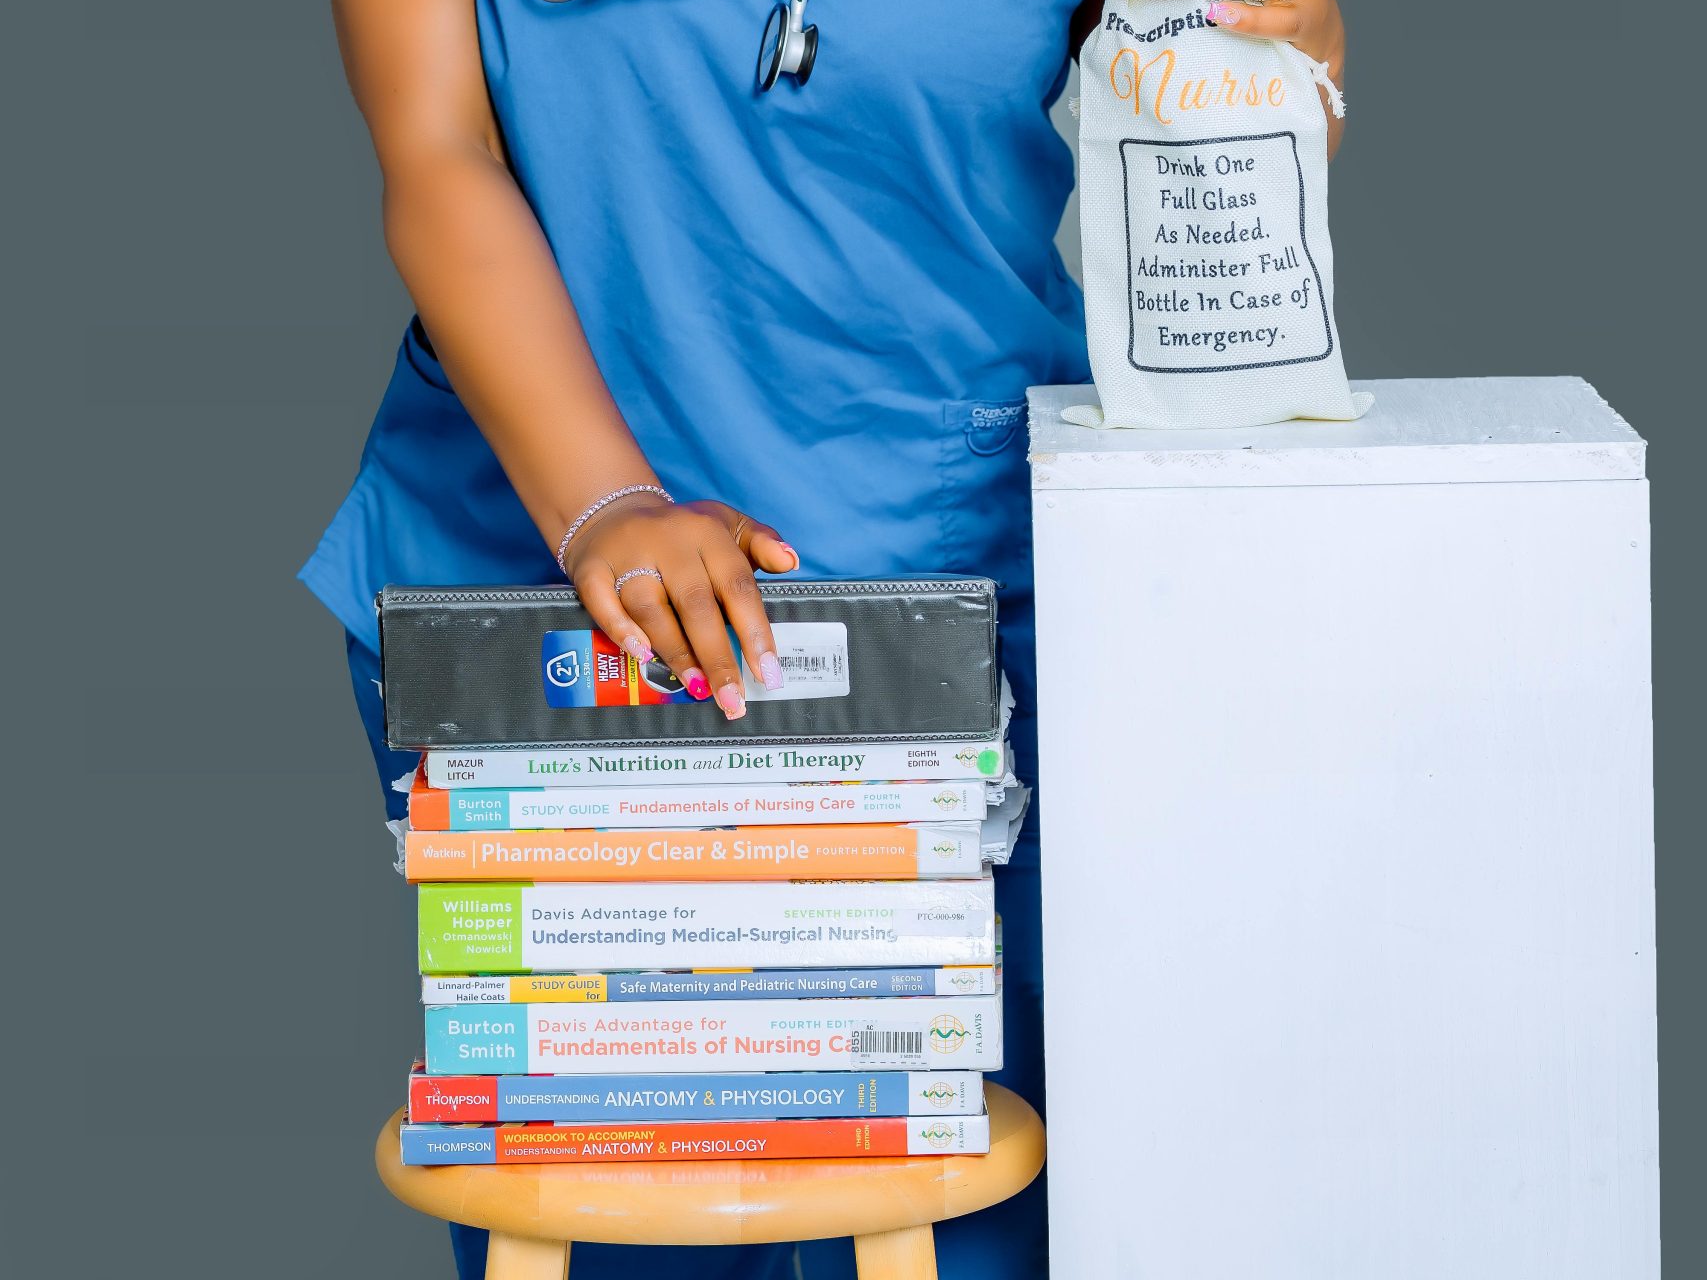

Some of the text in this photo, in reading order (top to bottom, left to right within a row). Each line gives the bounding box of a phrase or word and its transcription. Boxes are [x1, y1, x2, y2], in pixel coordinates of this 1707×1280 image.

[1110, 48, 1285, 125] Nurse
[1155, 155, 1255, 177] Drink One
[1160, 187, 1257, 211] Full Glass
[1155, 217, 1270, 244] As Needed.
[1137, 246, 1300, 278] Administer Full
[1136, 277, 1311, 312] Bottle In Case of
[1158, 326, 1286, 352] Emergency.
[583, 662, 591, 676] 530
[597, 653, 609, 682] HEAVY
[608, 655, 620, 679] DUTY
[908, 750, 937, 758] EIGHTH
[447, 758, 484, 768] MAZUR
[528, 751, 866, 775] Lutz's Nutrition and Diet Therapy
[908, 759, 940, 768] EDITION
[447, 772, 475, 780] LITCH
[458, 799, 502, 809] Burton
[864, 793, 900, 801] FOURTH
[521, 797, 855, 816] STUDY GUIDE Fundamentals of Nursing Care
[864, 802, 901, 810] EDITION
[465, 811, 502, 822] Smith
[422, 840, 905, 865] Watkins Pharmacology Clear & Simple FOURTH EDITION
[442, 901, 512, 913] Williams
[532, 906, 696, 921] Davis Advantage for
[784, 909, 841, 919] SEVENTH
[452, 916, 512, 931] Hopper
[917, 912, 965, 921] PTC-000-986
[442, 932, 512, 942] Otmanowski
[532, 926, 898, 945] Understanding Medical-Surgical Nursing
[466, 942, 512, 953] Nowicki
[437, 981, 505, 992] Linnard-Palmer
[531, 979, 600, 990] STUDY GUIDE
[620, 977, 878, 995] Safe Maternity and Pediatric Nursing Care
[891, 984, 923, 992] EDITION
[456, 993, 505, 1002] Haile Coats
[586, 991, 600, 1000] for
[448, 1020, 515, 1035] Burton
[538, 1017, 727, 1033] Davis Advantage for
[770, 1020, 821, 1029] FOURTH
[975, 1013, 983, 1039] DAVIS
[538, 1037, 697, 1056] Fundamentals
[704, 1036, 727, 1054] of
[735, 1035, 821, 1056] Nursing
[852, 1030, 860, 1053] 855
[458, 1044, 515, 1058] Smith
[426, 1095, 490, 1105] THOMPSON
[505, 1089, 845, 1107] UNDERSTANDING ANATOMY & PHYSIOLOGY
[504, 1131, 656, 1143] WORKBOOK TO ACCOMPANY
[427, 1142, 491, 1153] THOMPSON
[504, 1139, 767, 1156] UNDERSTANDING ANATOMY & PHYSIOLOGY
